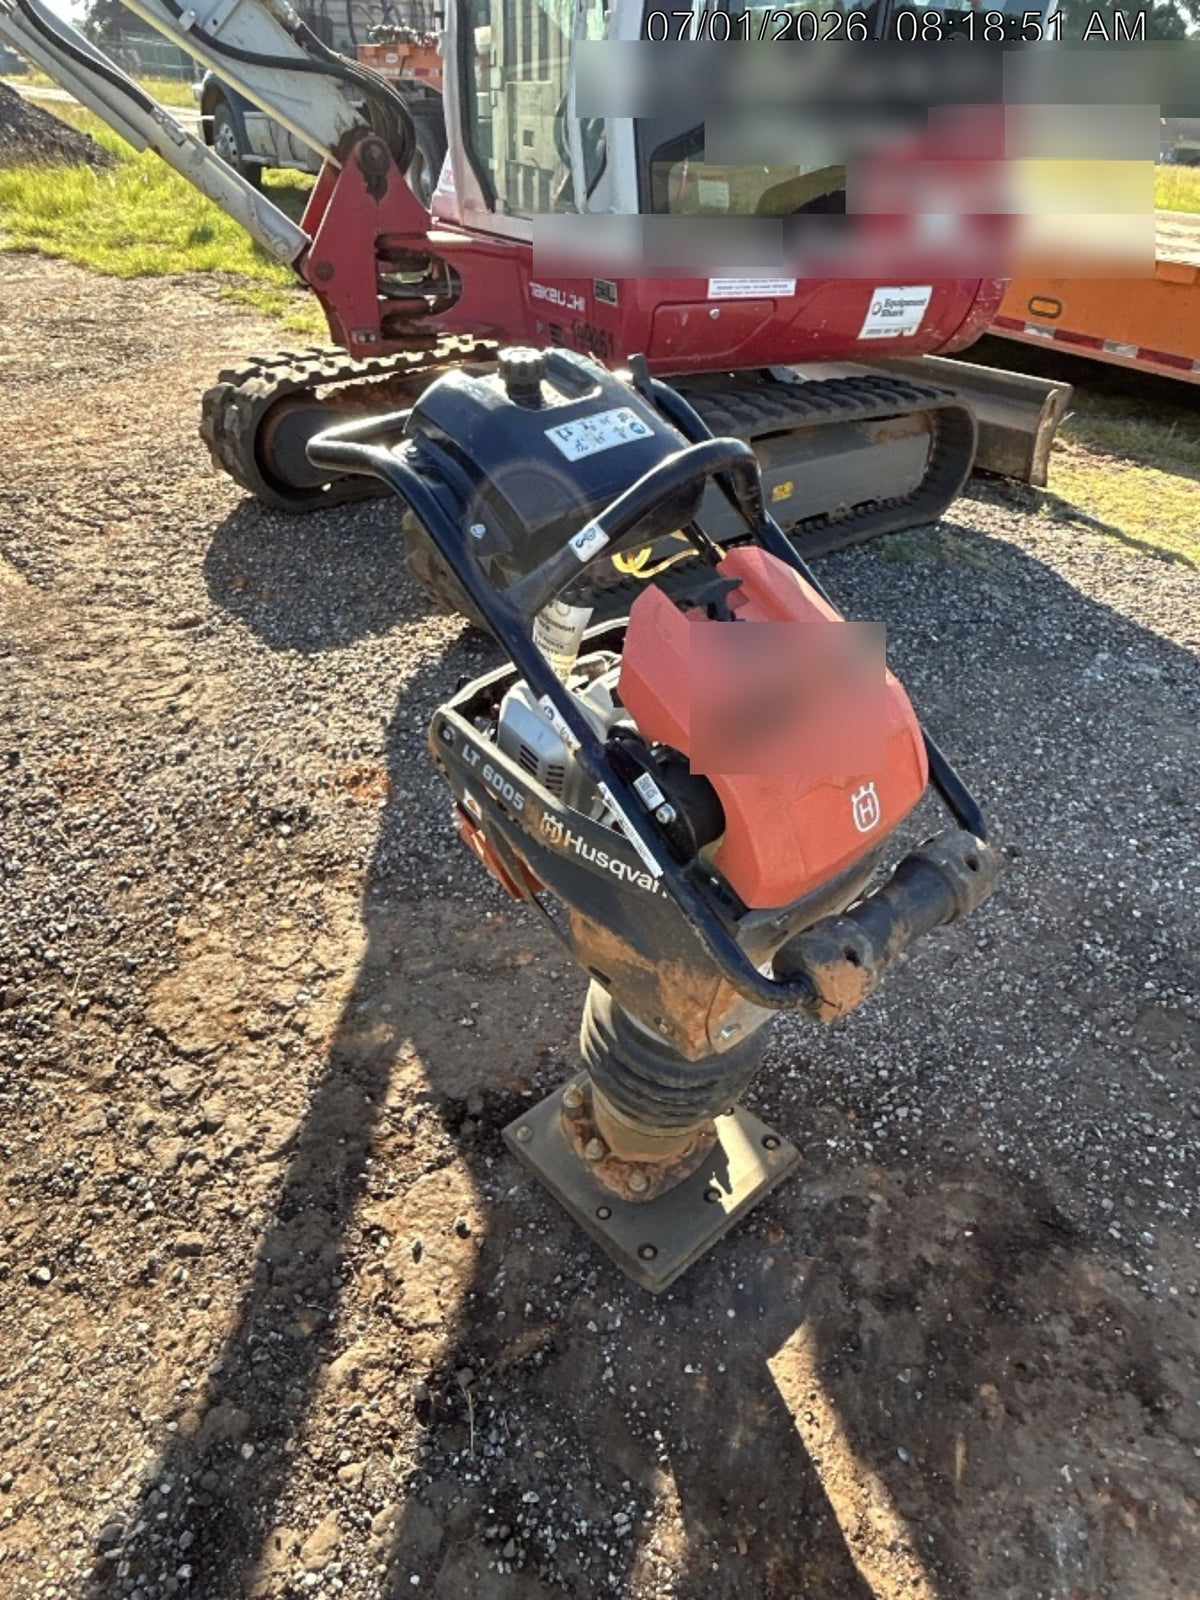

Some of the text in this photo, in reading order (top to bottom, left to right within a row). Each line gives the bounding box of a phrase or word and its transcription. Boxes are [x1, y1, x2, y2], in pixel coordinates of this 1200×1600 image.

[881, 309, 905, 317] Share
[884, 298, 927, 309] Equipment
[462, 744, 525, 811] LT 6005
[563, 829, 668, 898] Husqvar
